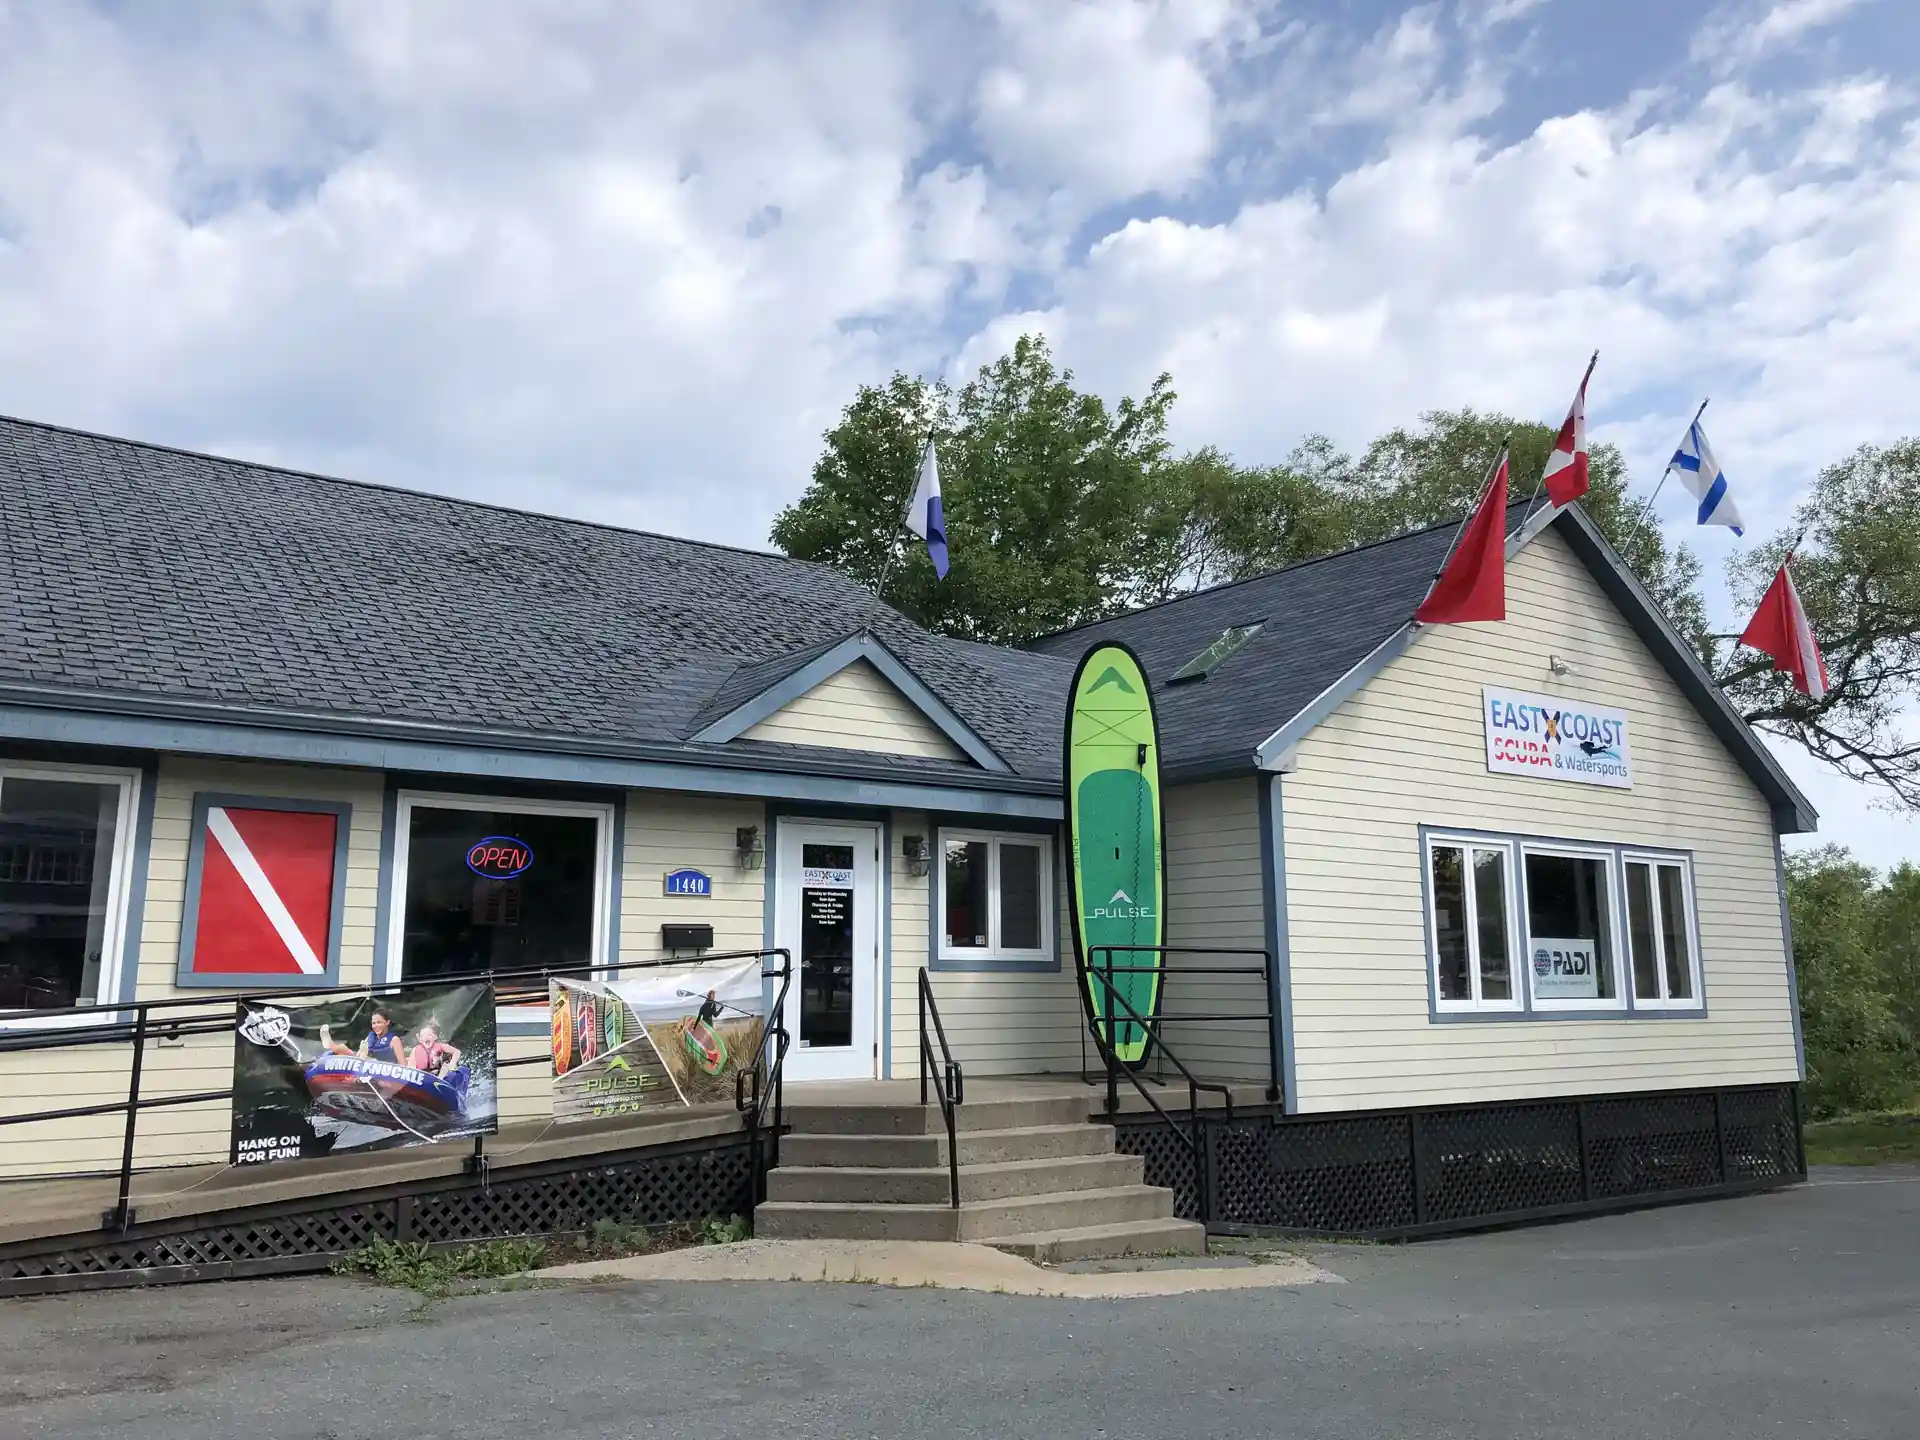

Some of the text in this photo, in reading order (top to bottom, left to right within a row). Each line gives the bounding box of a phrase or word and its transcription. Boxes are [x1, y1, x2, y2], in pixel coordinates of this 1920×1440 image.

[1491, 700, 1623, 746] EAST COAST
[1494, 737, 1628, 778] SCUBA & Watersports
[470, 847, 528, 869] OPEN
[675, 877, 704, 893] 1440
[1092, 907, 1152, 919] PULSE
[1553, 951, 1591, 976] PADI
[324, 1057, 425, 1086] WHITE KNUCKLE
[584, 1074, 656, 1092] PULSE
[238, 1135, 301, 1151] HANG ON
[237, 1146, 300, 1163] FOR FUN!
